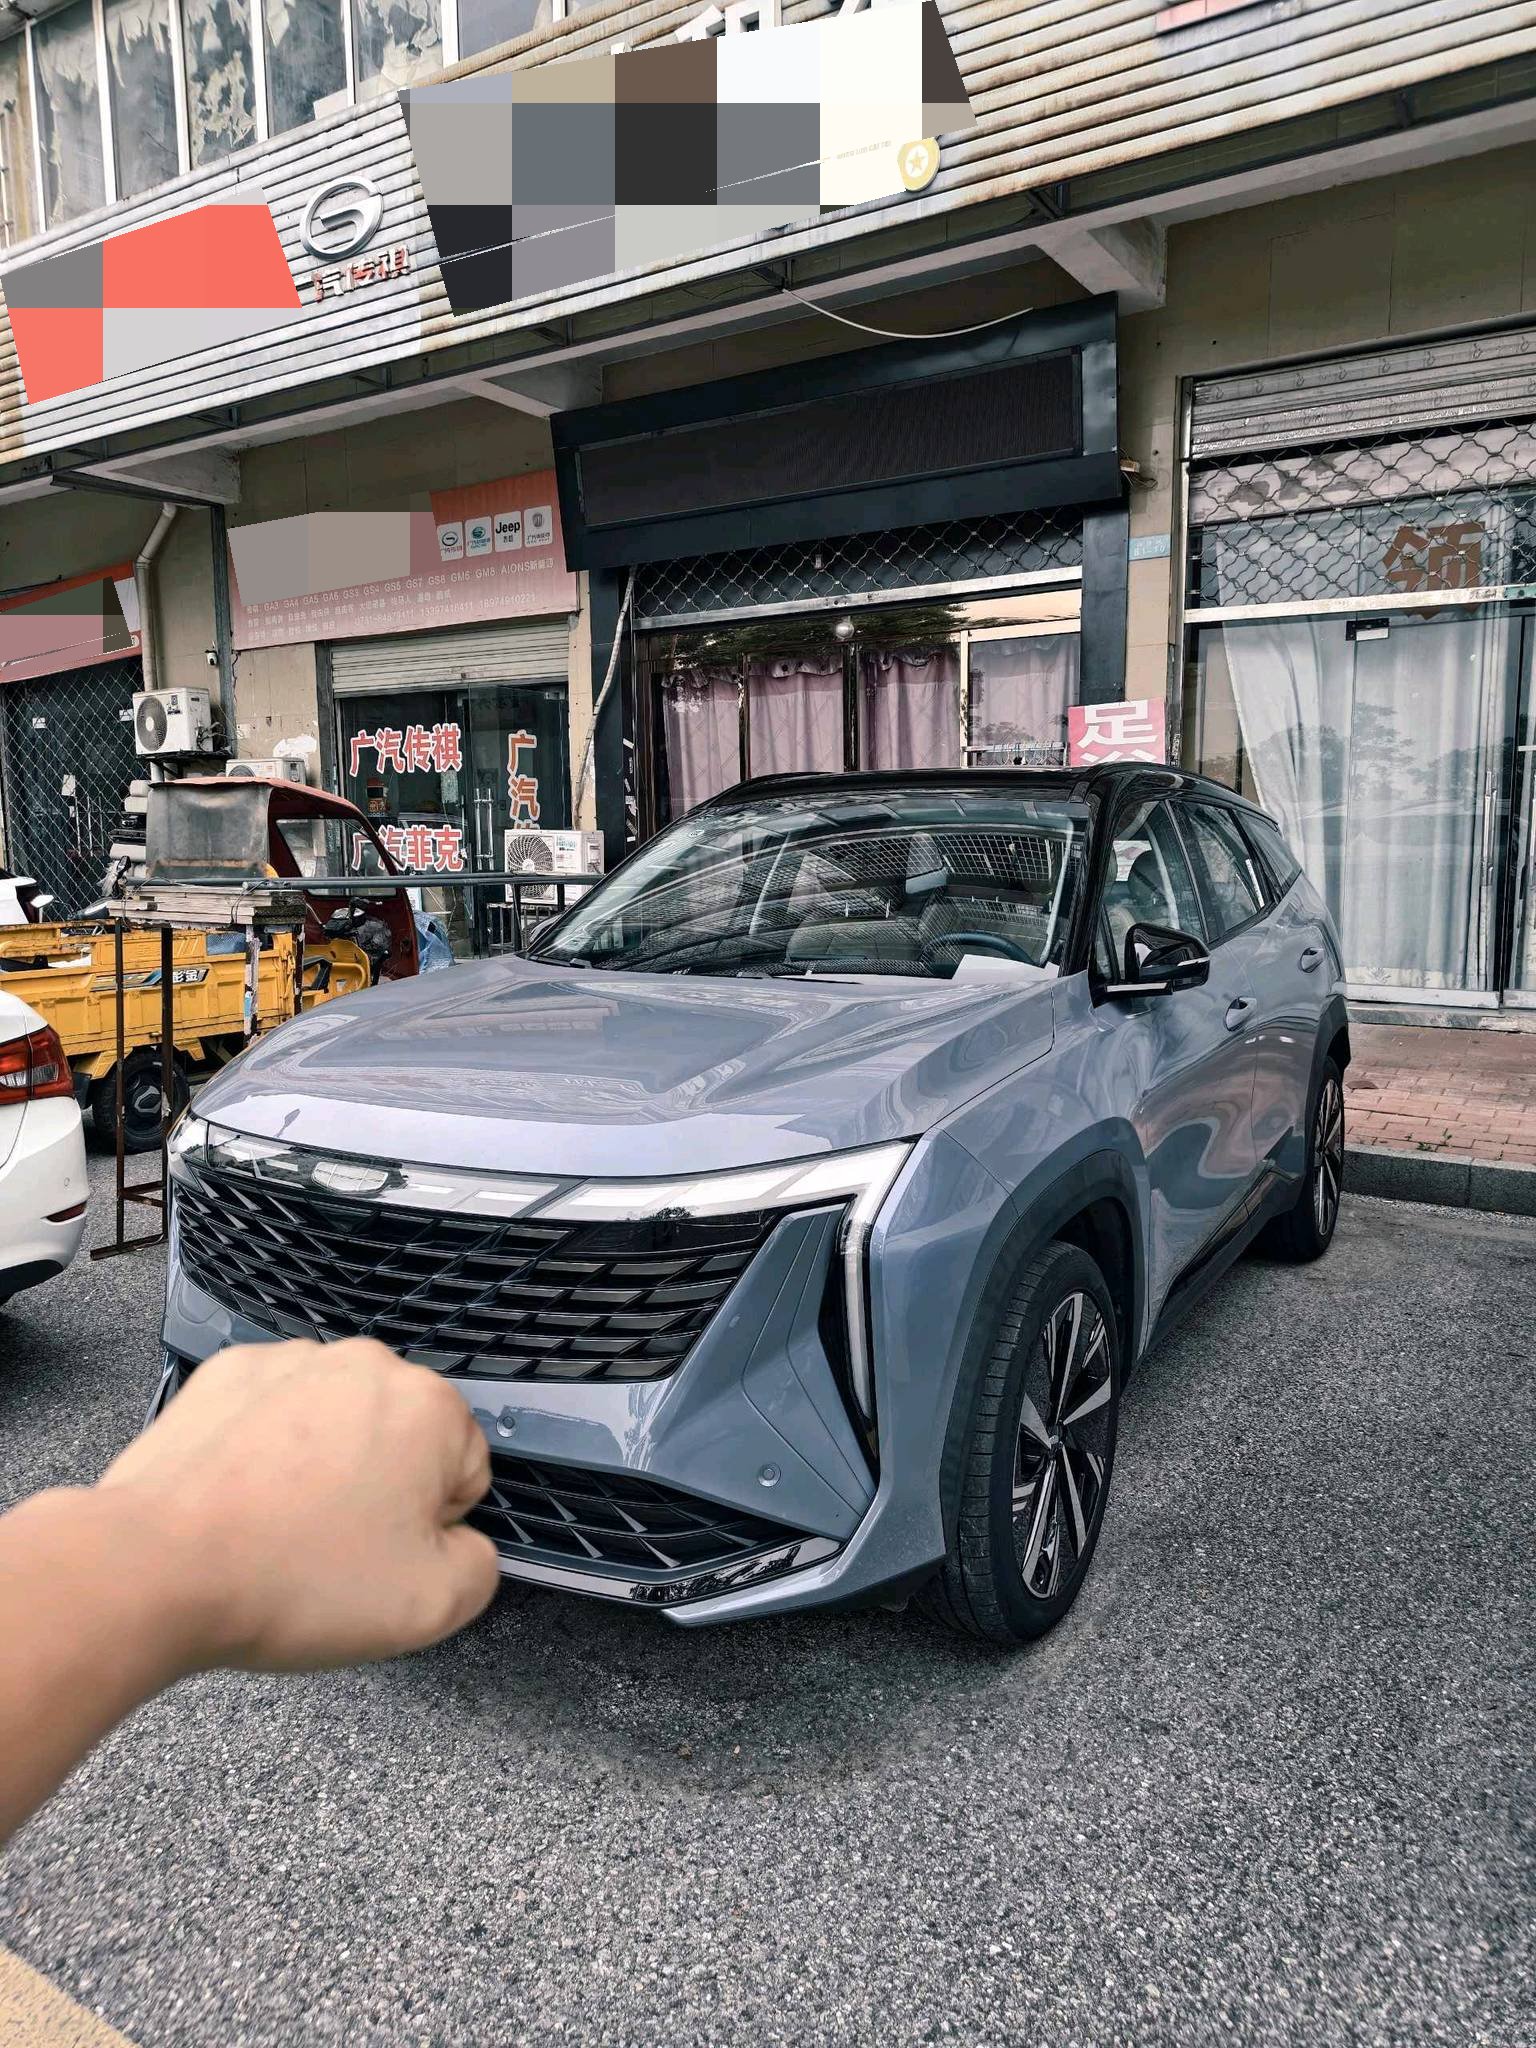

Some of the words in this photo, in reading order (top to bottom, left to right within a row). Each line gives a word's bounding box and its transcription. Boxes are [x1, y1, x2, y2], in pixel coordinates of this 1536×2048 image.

[496, 521, 520, 534] Jeep
[349, 723, 463, 777] 广汽传祺
[507, 729, 541, 829] 广汽
[351, 824, 464, 872] 广汽菲克
